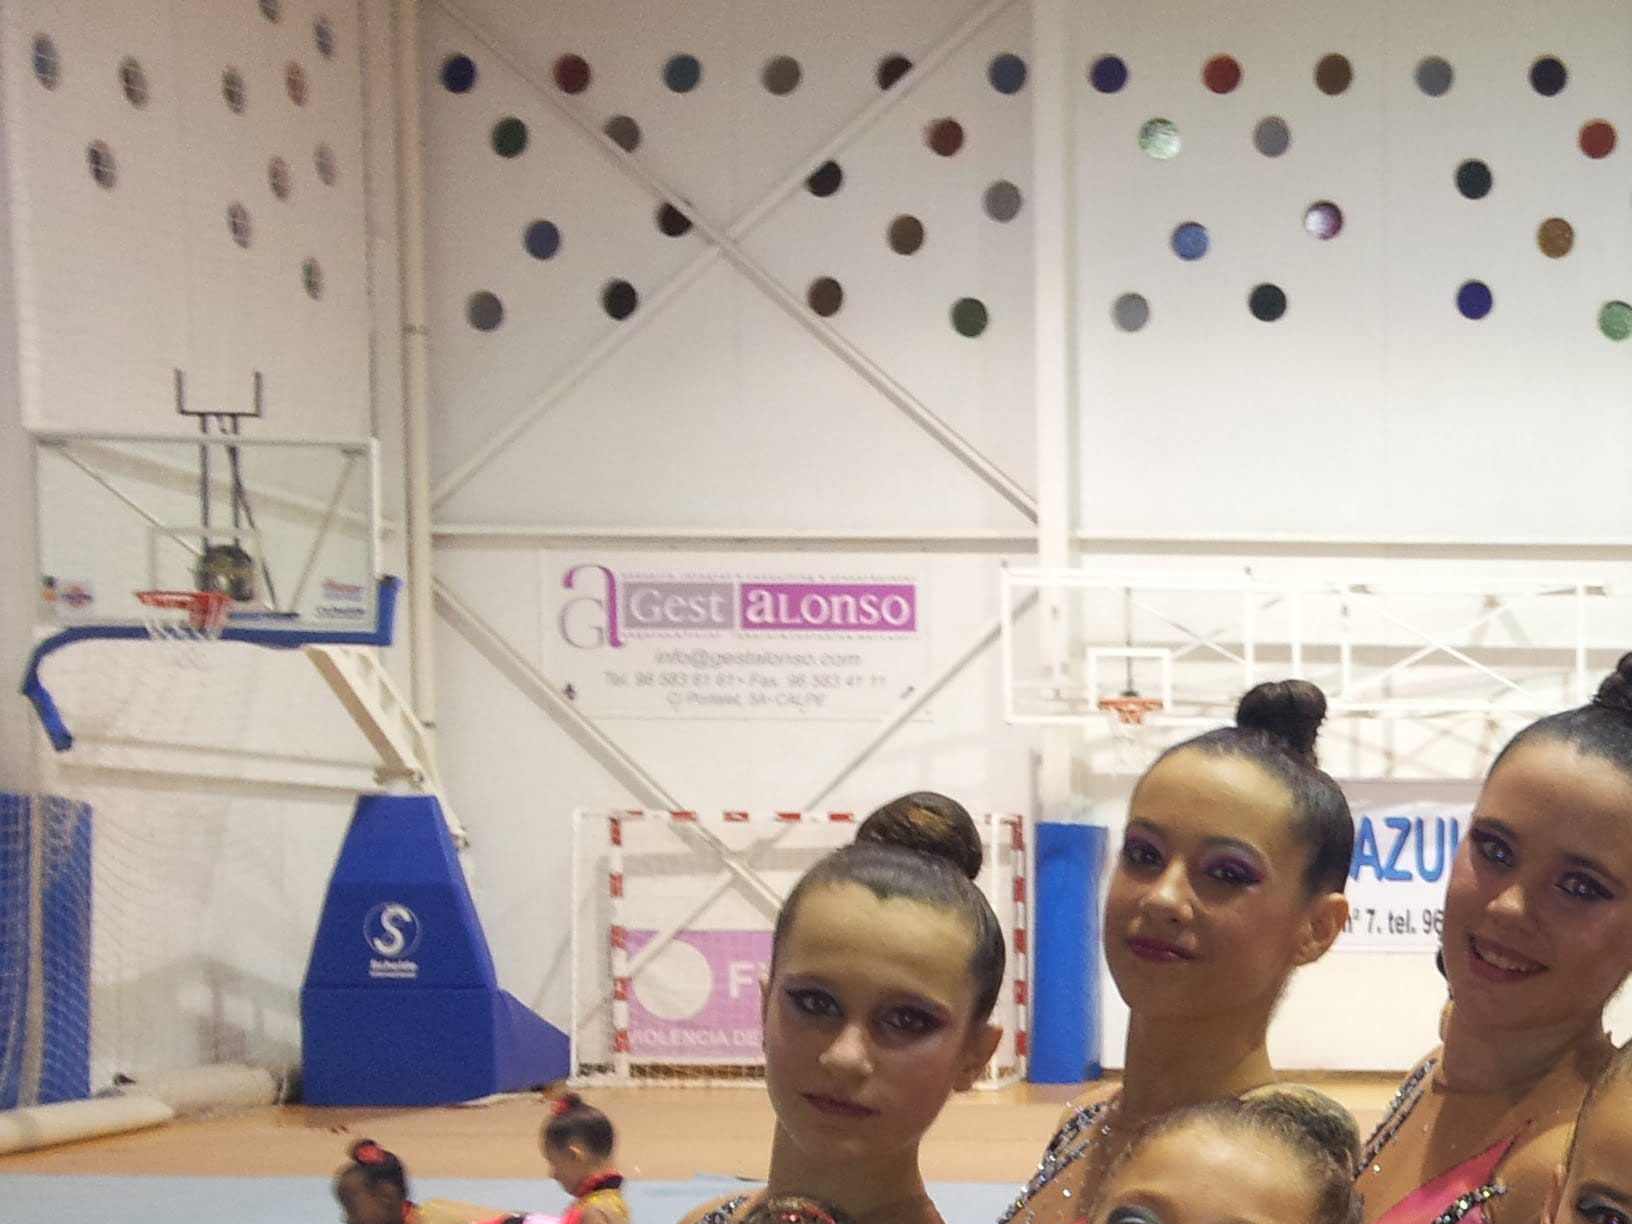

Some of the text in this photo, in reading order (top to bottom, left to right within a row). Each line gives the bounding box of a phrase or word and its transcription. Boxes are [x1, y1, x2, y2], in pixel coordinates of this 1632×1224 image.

[629, 587, 726, 623] Gest
[1366, 908, 1382, 934] 7.
[1388, 909, 1416, 934] tel.
